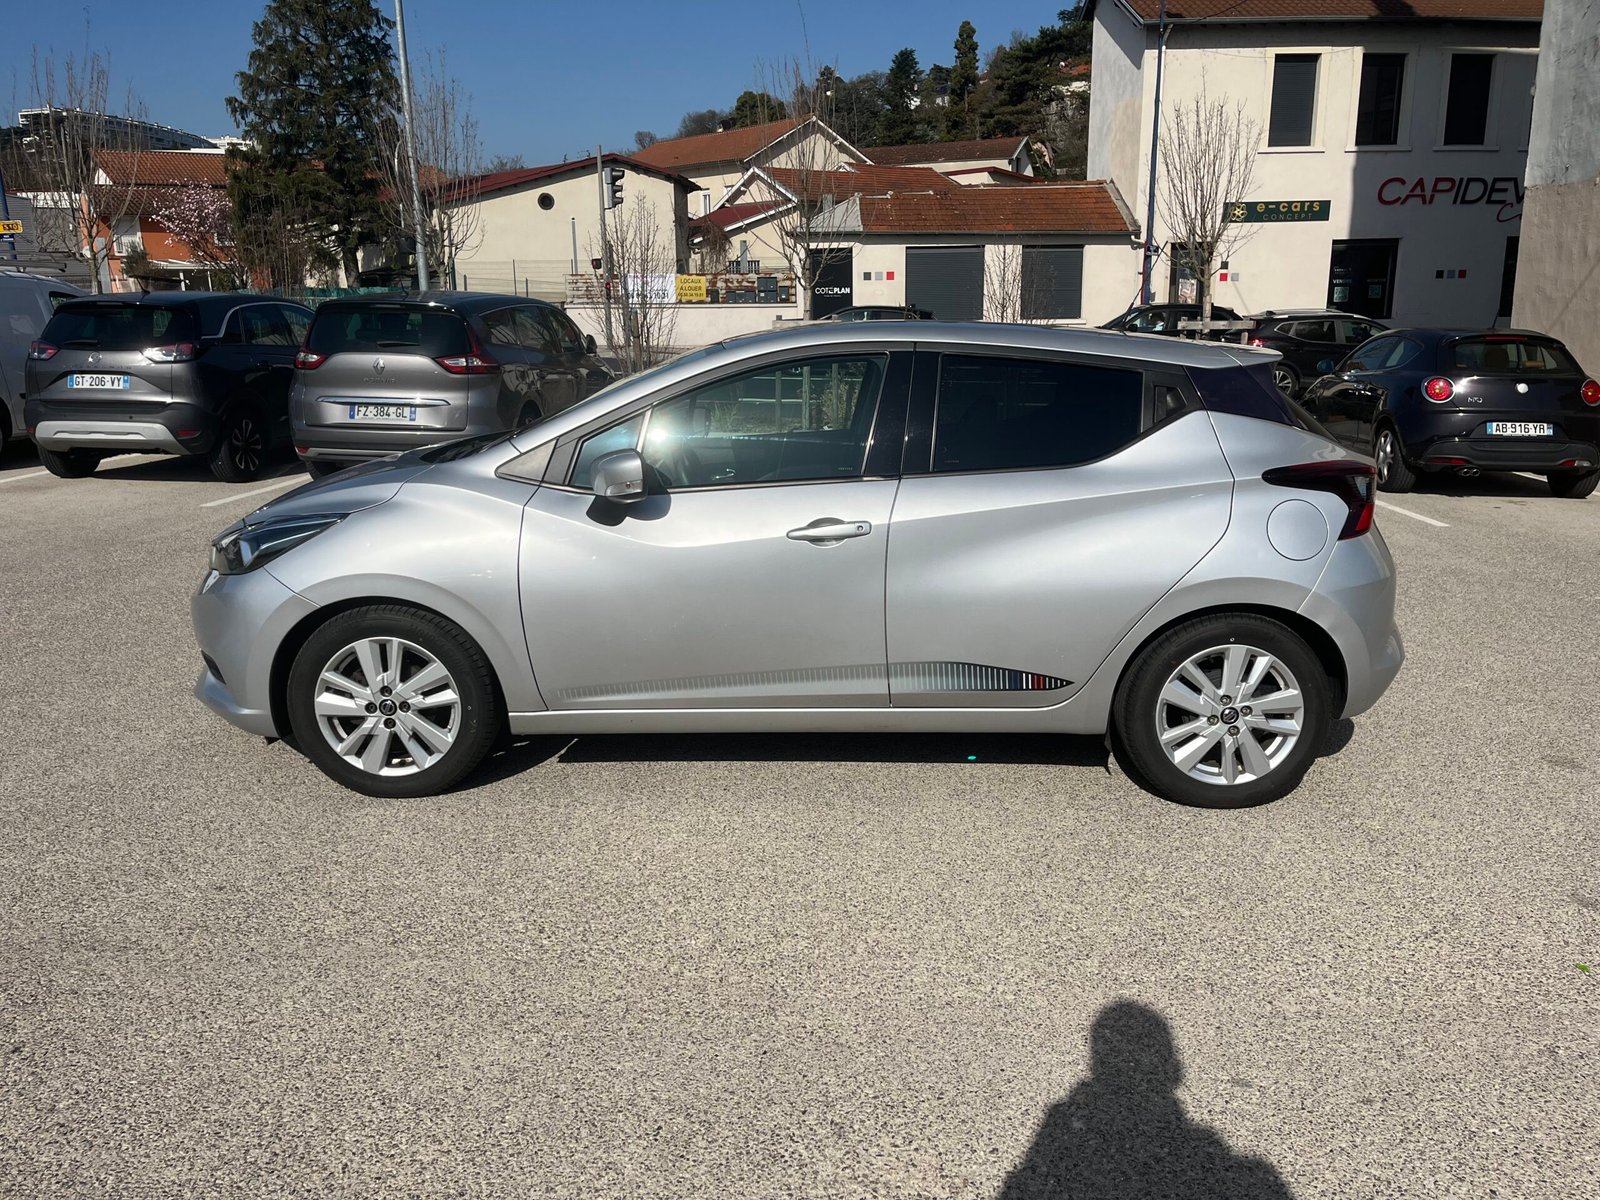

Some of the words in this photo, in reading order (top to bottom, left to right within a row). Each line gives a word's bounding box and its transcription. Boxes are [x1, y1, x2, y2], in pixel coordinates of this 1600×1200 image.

[1256, 202, 1320, 213] e-cars
[1262, 213, 1313, 221] CONCEPT
[74, 376, 122, 388] GT-206-VY
[356, 405, 407, 419] FZ-384-GL
[1495, 423, 1545, 434] AB-916-YR
